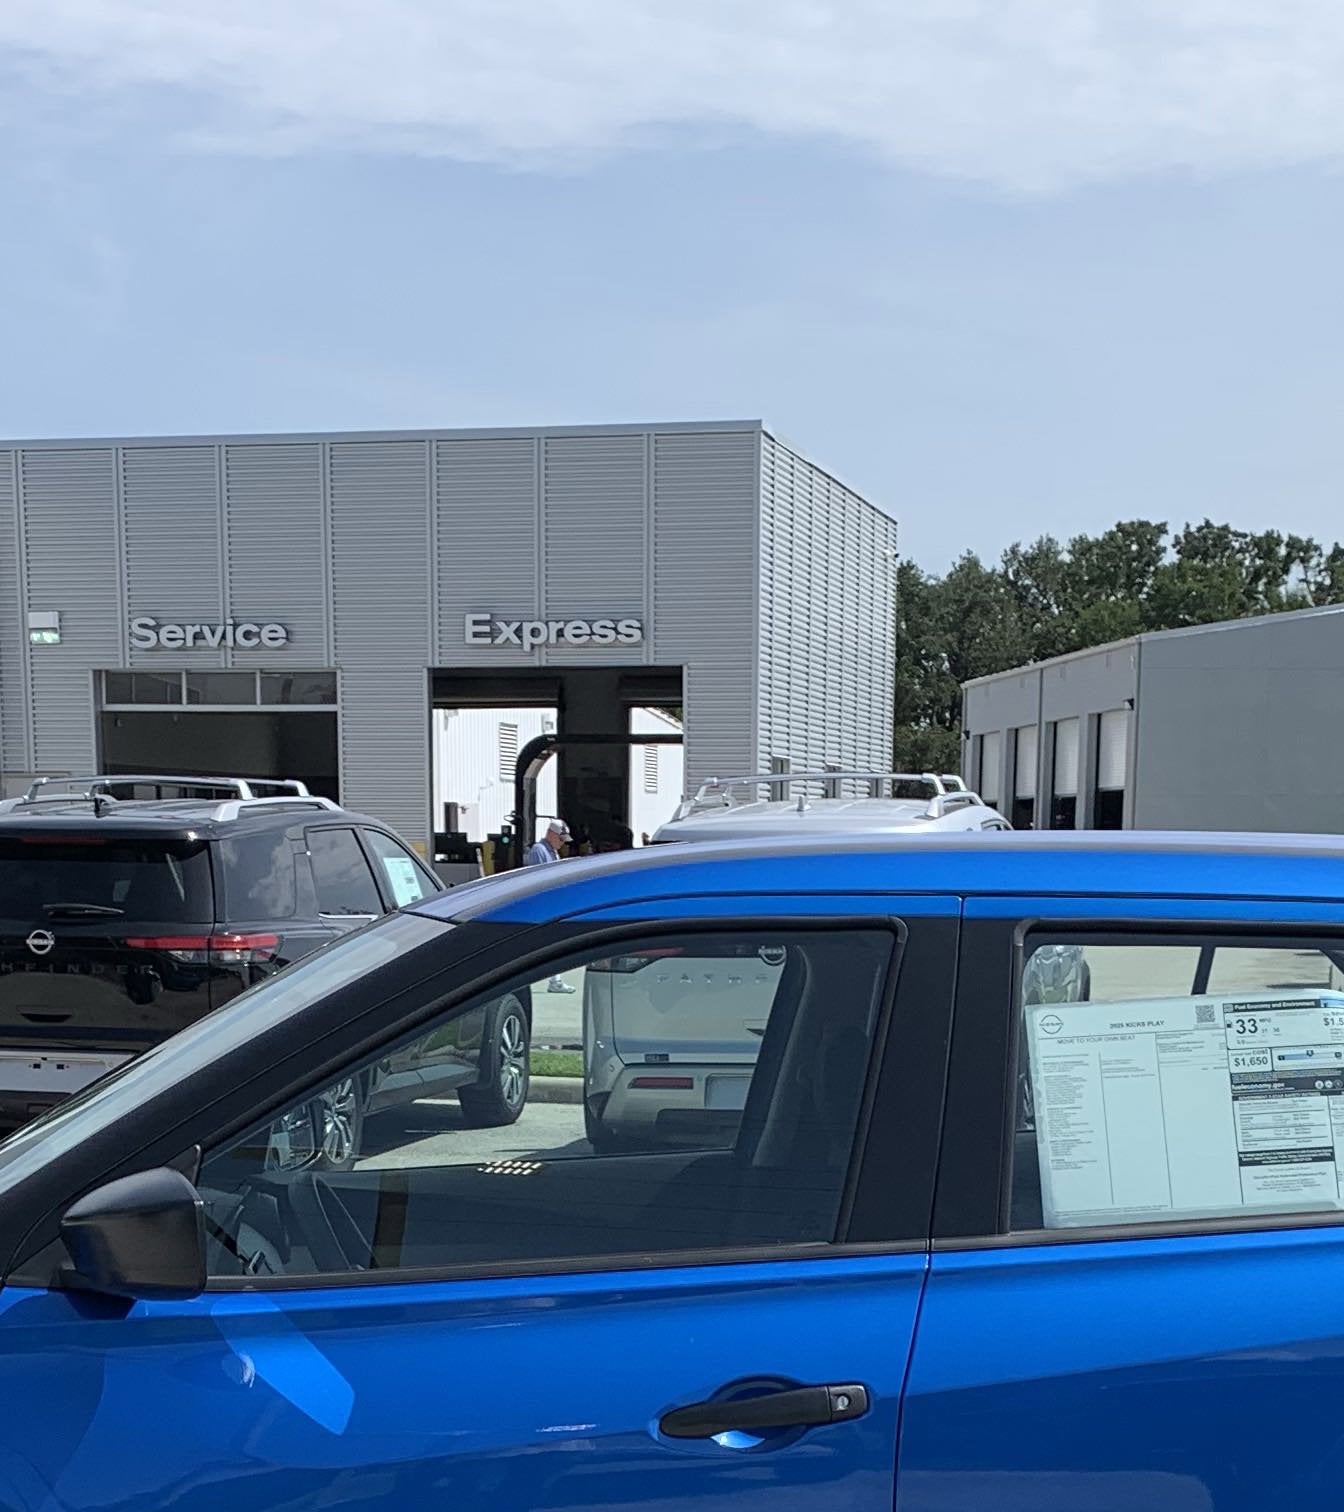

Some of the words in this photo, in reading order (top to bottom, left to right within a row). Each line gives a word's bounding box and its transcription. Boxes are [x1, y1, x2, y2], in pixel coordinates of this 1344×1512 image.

[130, 617, 290, 649] Service
[463, 612, 644, 652] Express
[1236, 1018, 1258, 1035] 33
[1234, 1055, 1269, 1068] $1,650
